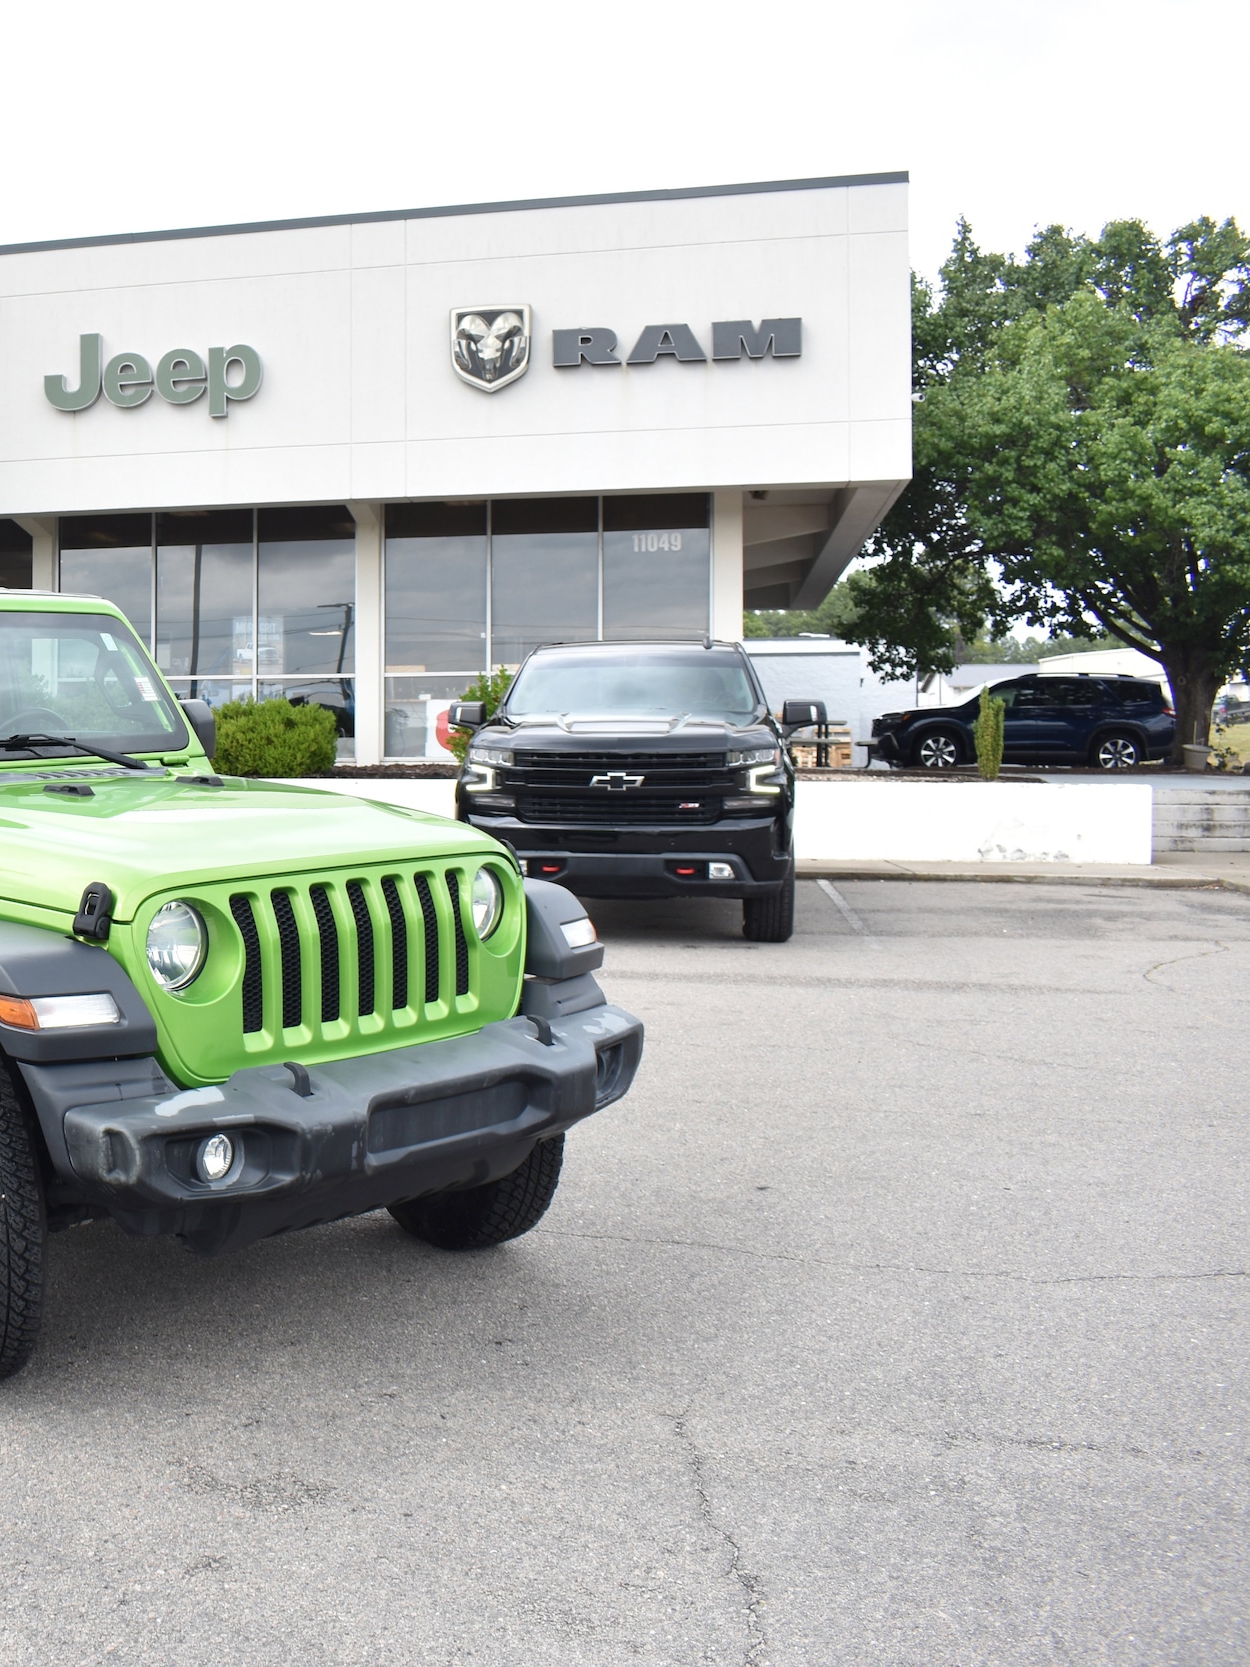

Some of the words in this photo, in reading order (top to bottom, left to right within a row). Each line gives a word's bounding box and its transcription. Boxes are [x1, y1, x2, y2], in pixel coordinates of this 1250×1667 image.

[552, 317, 803, 368] RAM
[44, 332, 263, 418] Jeep
[632, 532, 681, 552] 11049
